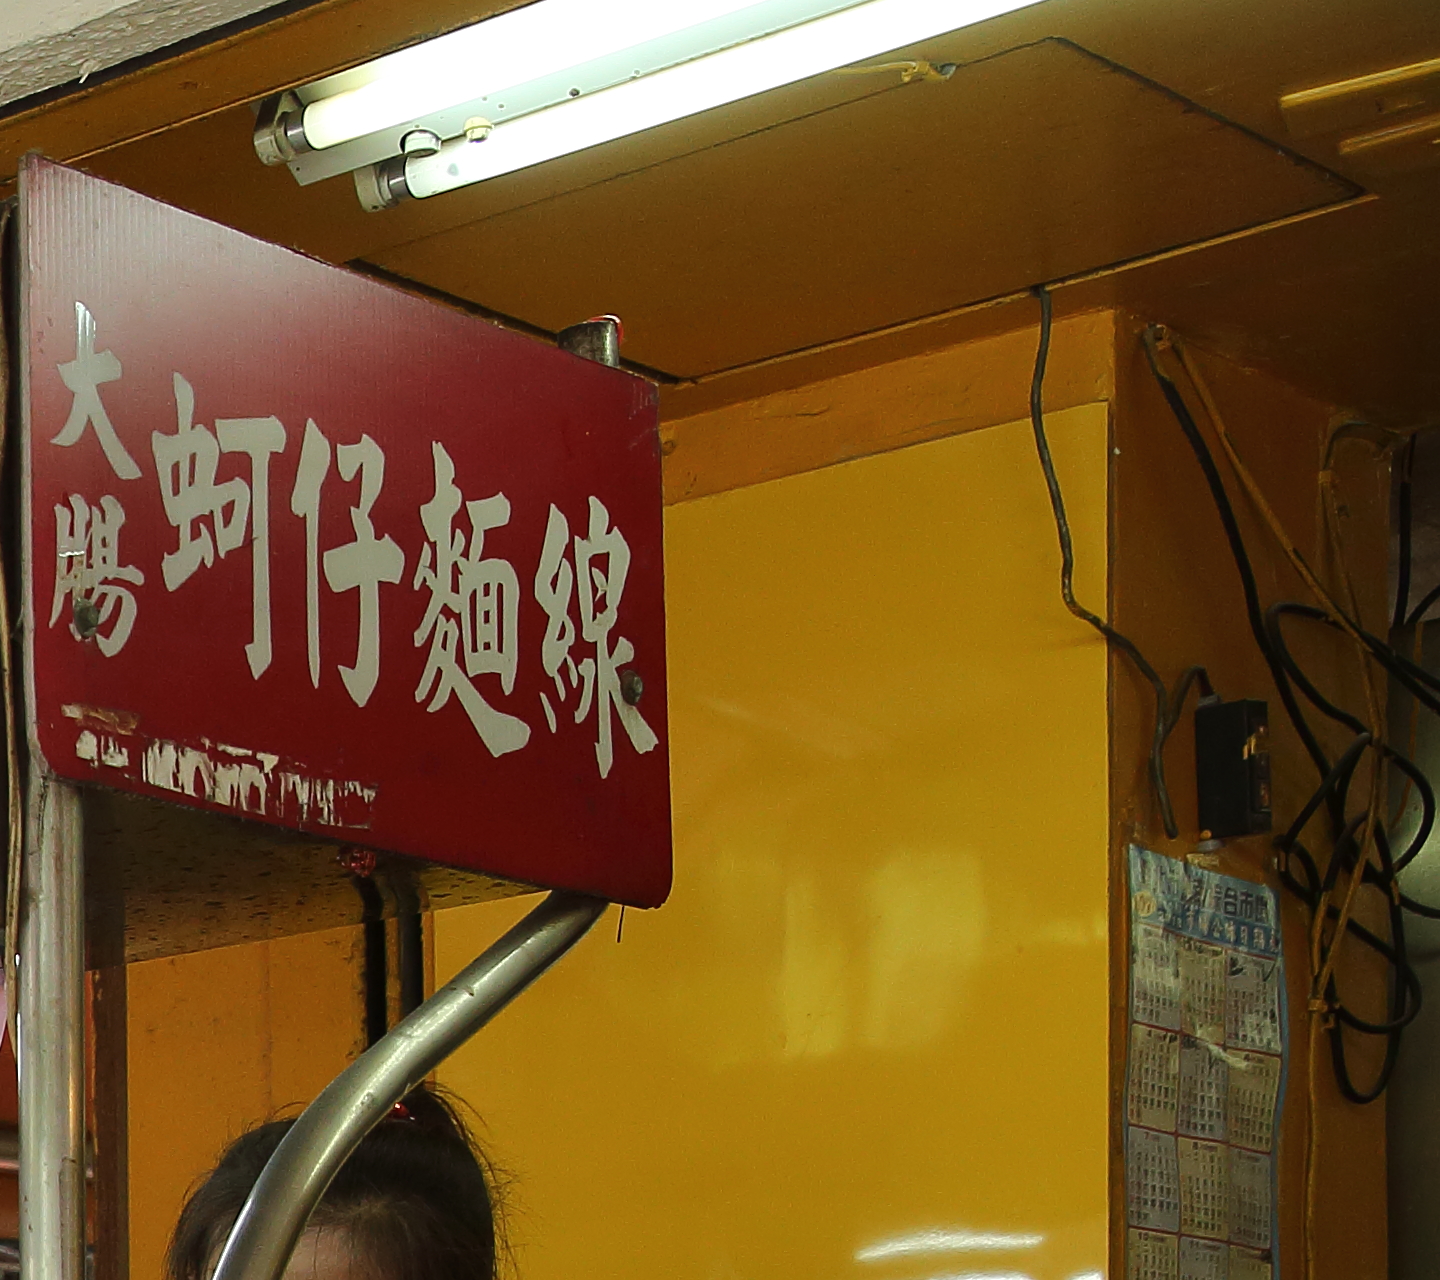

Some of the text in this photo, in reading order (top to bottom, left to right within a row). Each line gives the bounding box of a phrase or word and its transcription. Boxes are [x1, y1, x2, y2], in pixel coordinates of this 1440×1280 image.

[48, 301, 144, 658] 大腸
[151, 371, 660, 780] 蚵仔麵線
